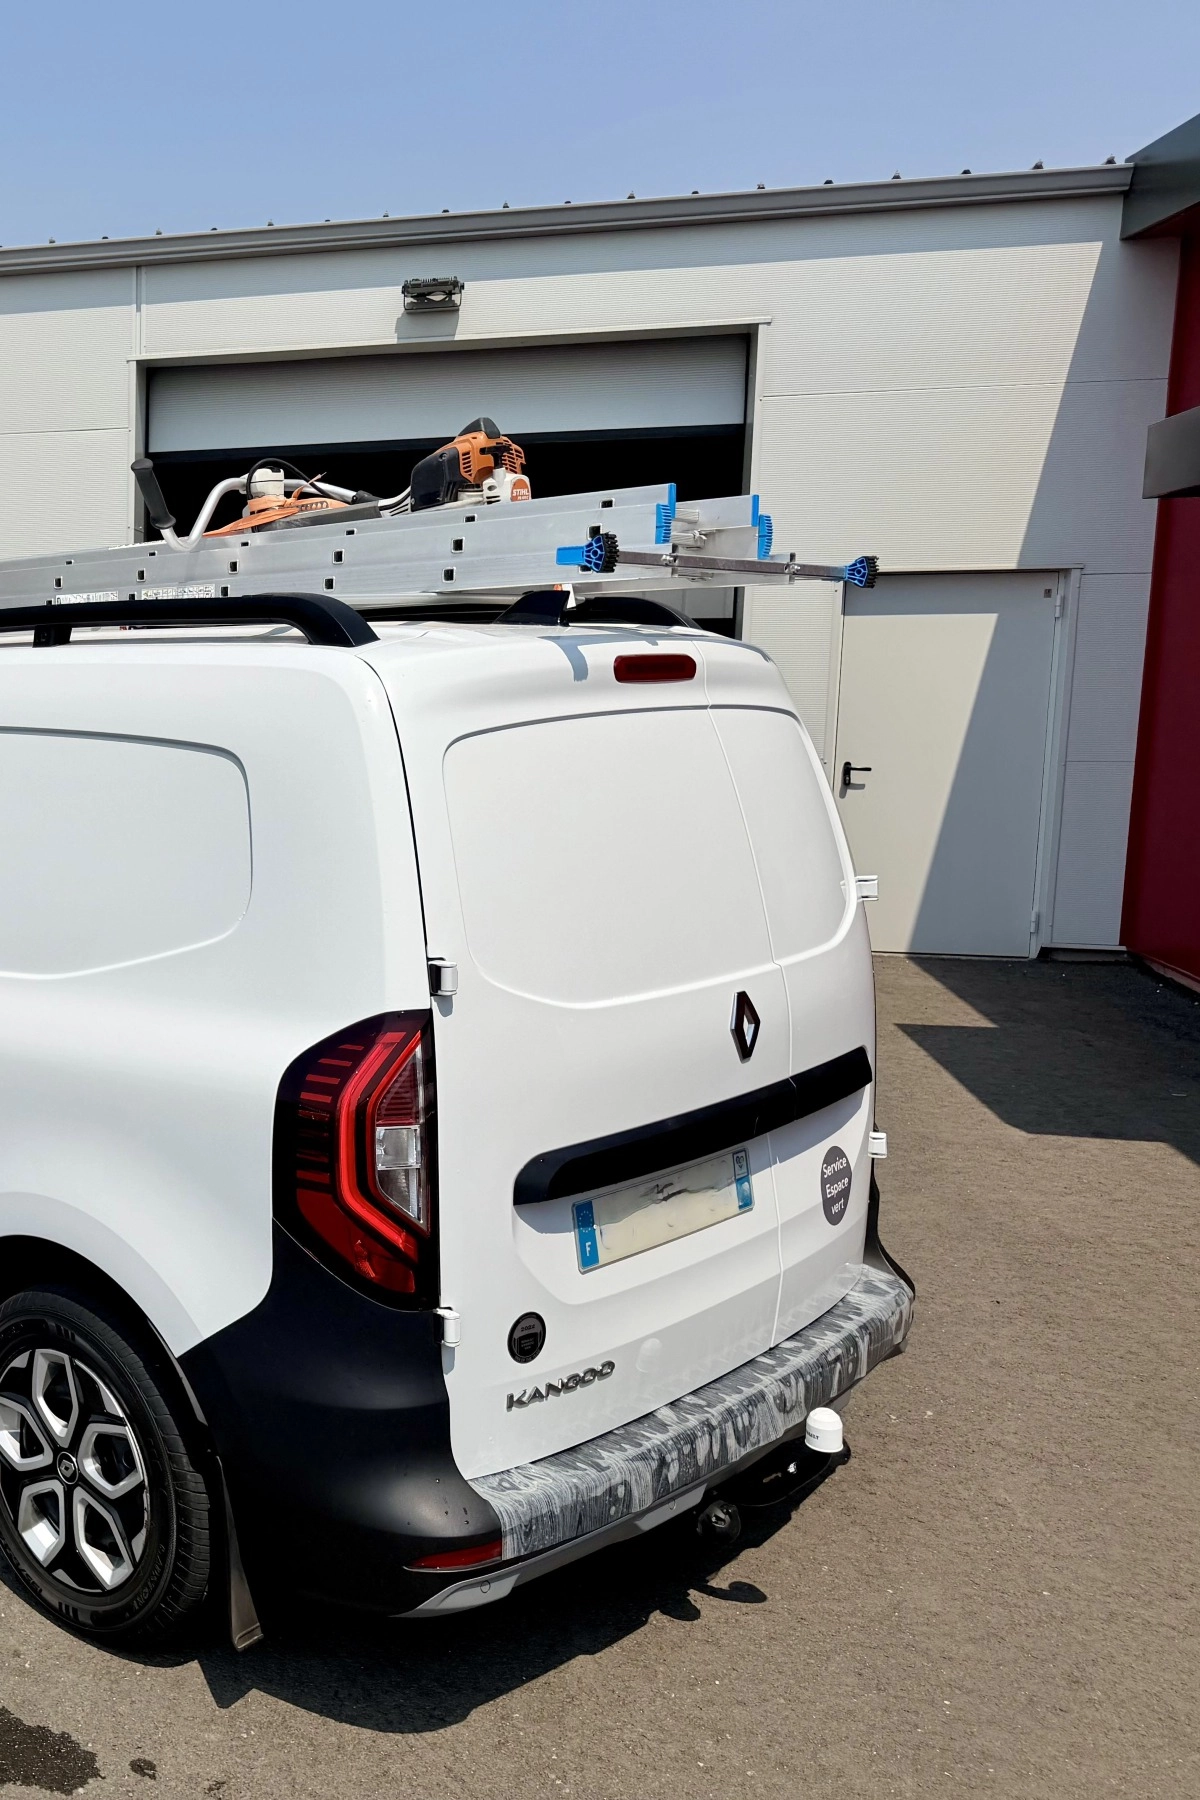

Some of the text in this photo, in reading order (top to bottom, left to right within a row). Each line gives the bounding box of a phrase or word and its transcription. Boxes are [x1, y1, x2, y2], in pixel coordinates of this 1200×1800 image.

[512, 488, 530, 496] STIHL
[823, 1156, 847, 1178] Service
[826, 1177, 849, 1198] Espace
[831, 1198, 844, 1215] vert
[585, 1241, 592, 1257] F
[520, 1324, 535, 1332] 2022
[506, 1360, 616, 1410] KANGOO
